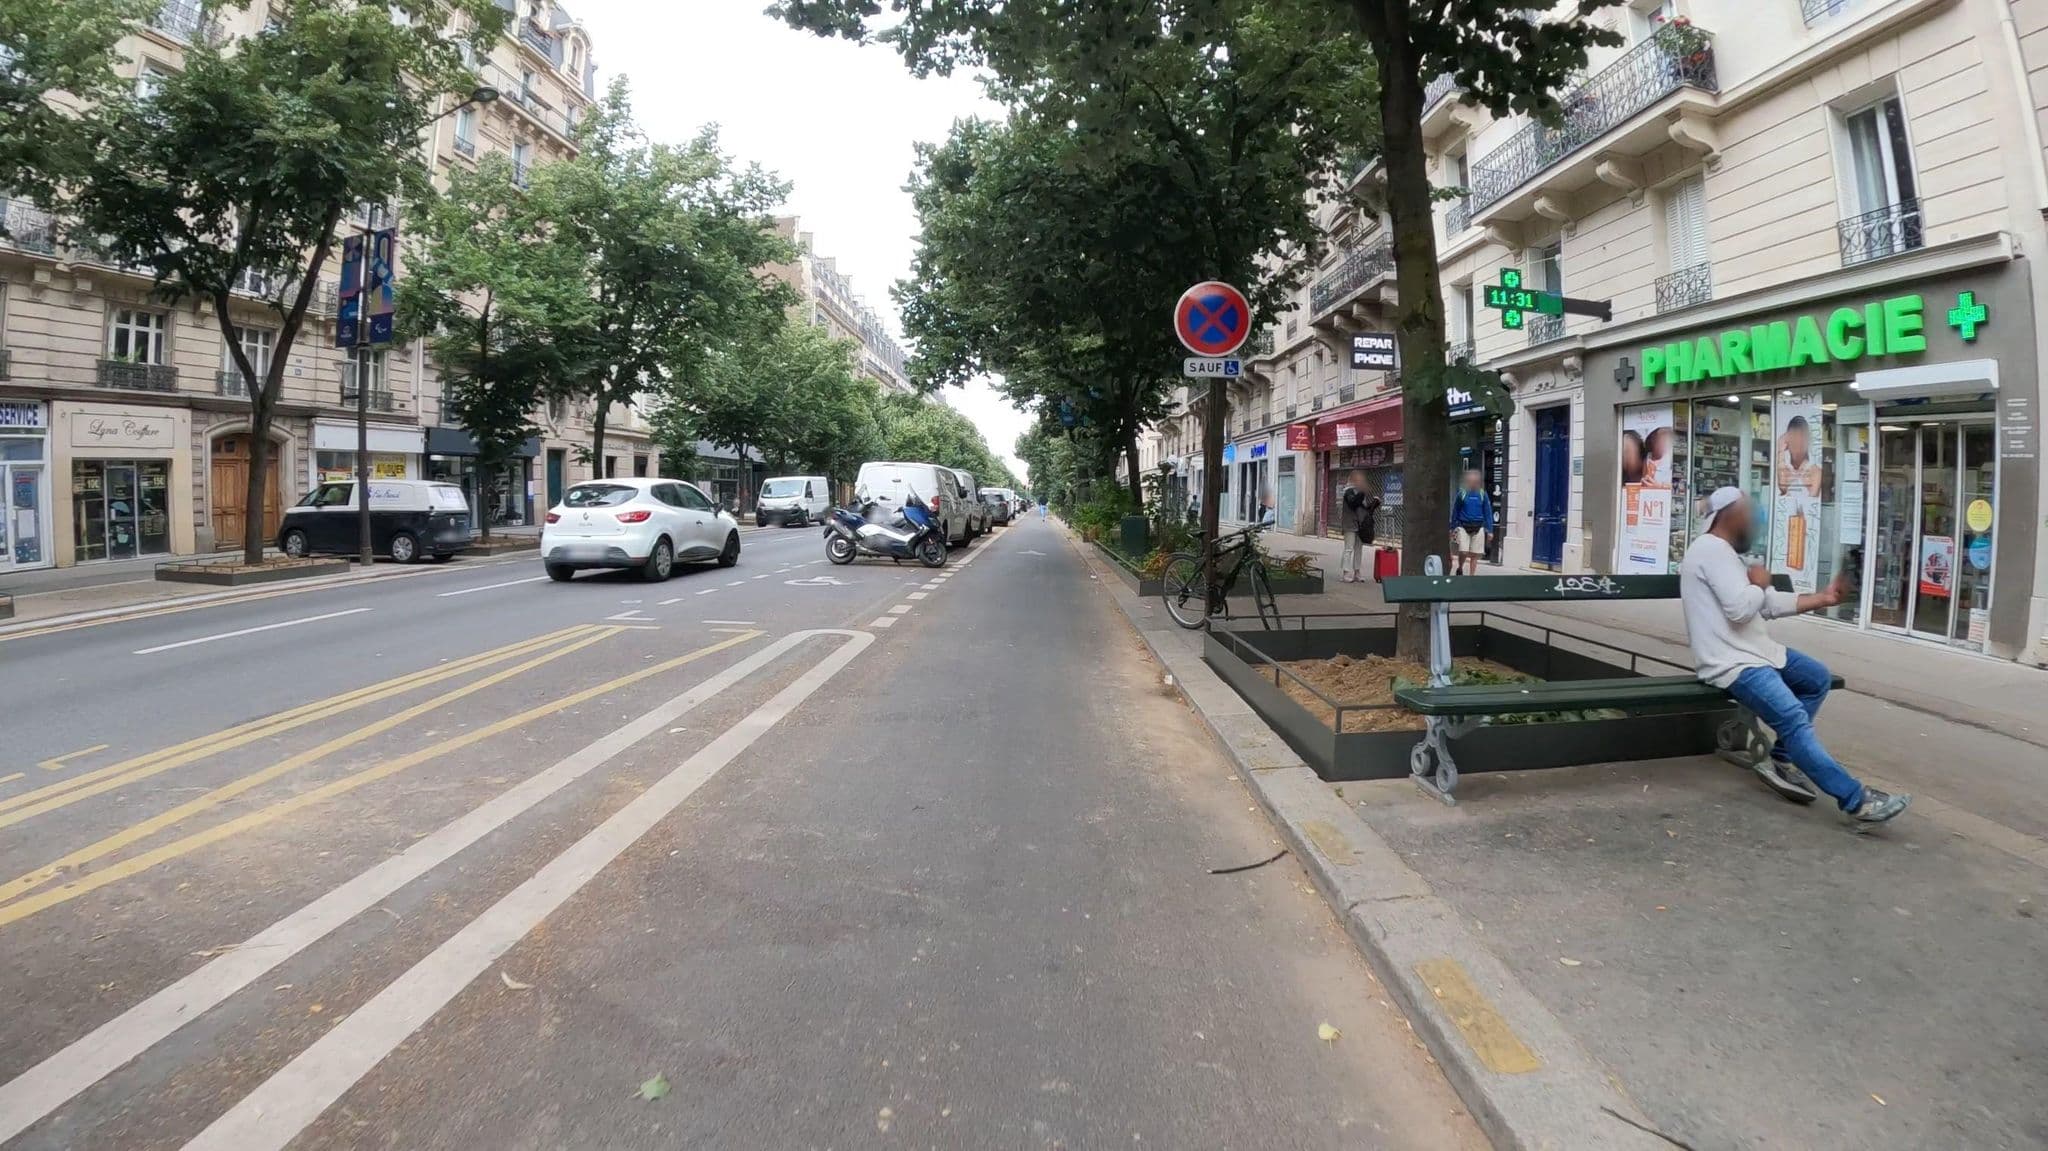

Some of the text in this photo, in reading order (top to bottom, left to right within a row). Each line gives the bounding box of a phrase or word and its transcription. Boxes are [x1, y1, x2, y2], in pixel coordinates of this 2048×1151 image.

[1491, 289, 1534, 308] 11:31
[1354, 336, 1392, 349] REPAR
[1641, 294, 1927, 388] PHARMACIE
[1354, 353, 1393, 365] IPHONE
[1189, 362, 1222, 373] SAUF
